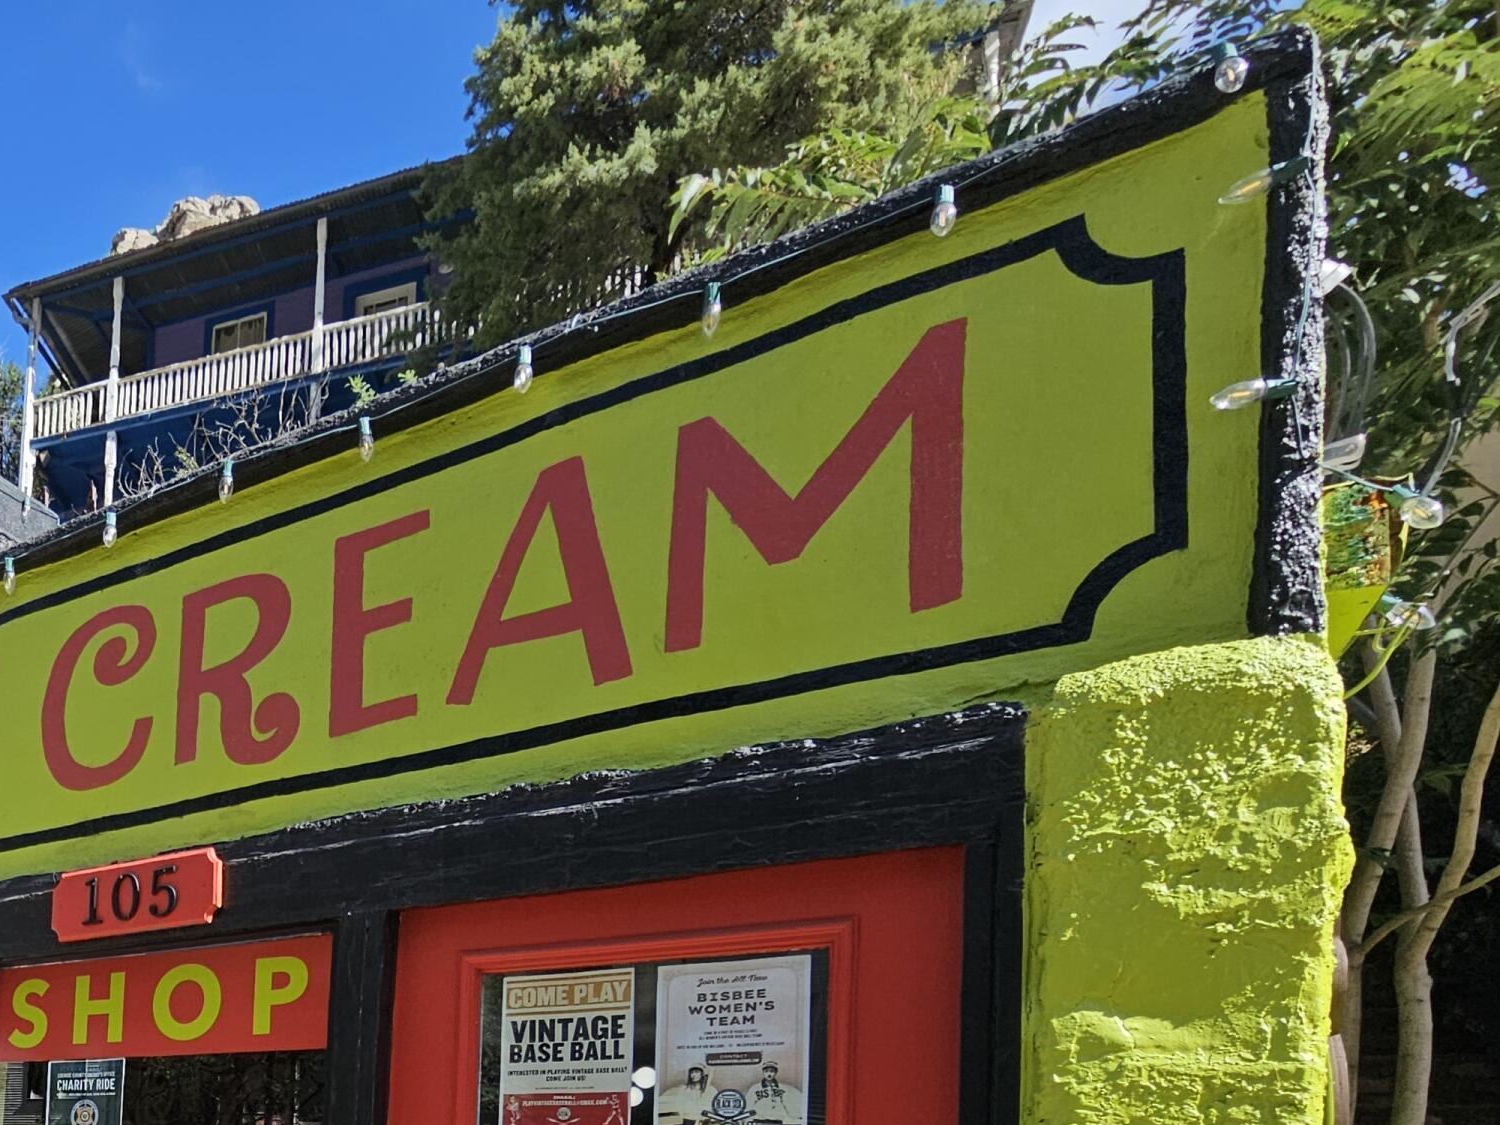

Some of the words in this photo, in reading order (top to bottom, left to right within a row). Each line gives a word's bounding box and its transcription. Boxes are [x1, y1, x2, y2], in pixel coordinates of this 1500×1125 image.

[40, 318, 967, 790] CREAM
[81, 864, 177, 926] 105
[8, 955, 310, 1049] SHOP
[508, 985, 569, 1009] COME
[574, 981, 629, 1005] PLAY
[688, 1000, 775, 1016] WOMEN'S
[697, 989, 767, 1002] BISBEE
[510, 1014, 626, 1044] VINTAGE
[706, 1015, 755, 1027] TEAM
[509, 1042, 564, 1064] BASE
[570, 1040, 625, 1062] BALL
[57, 1078, 94, 1091] CHARITY
[96, 1077, 116, 1090] RIDE
